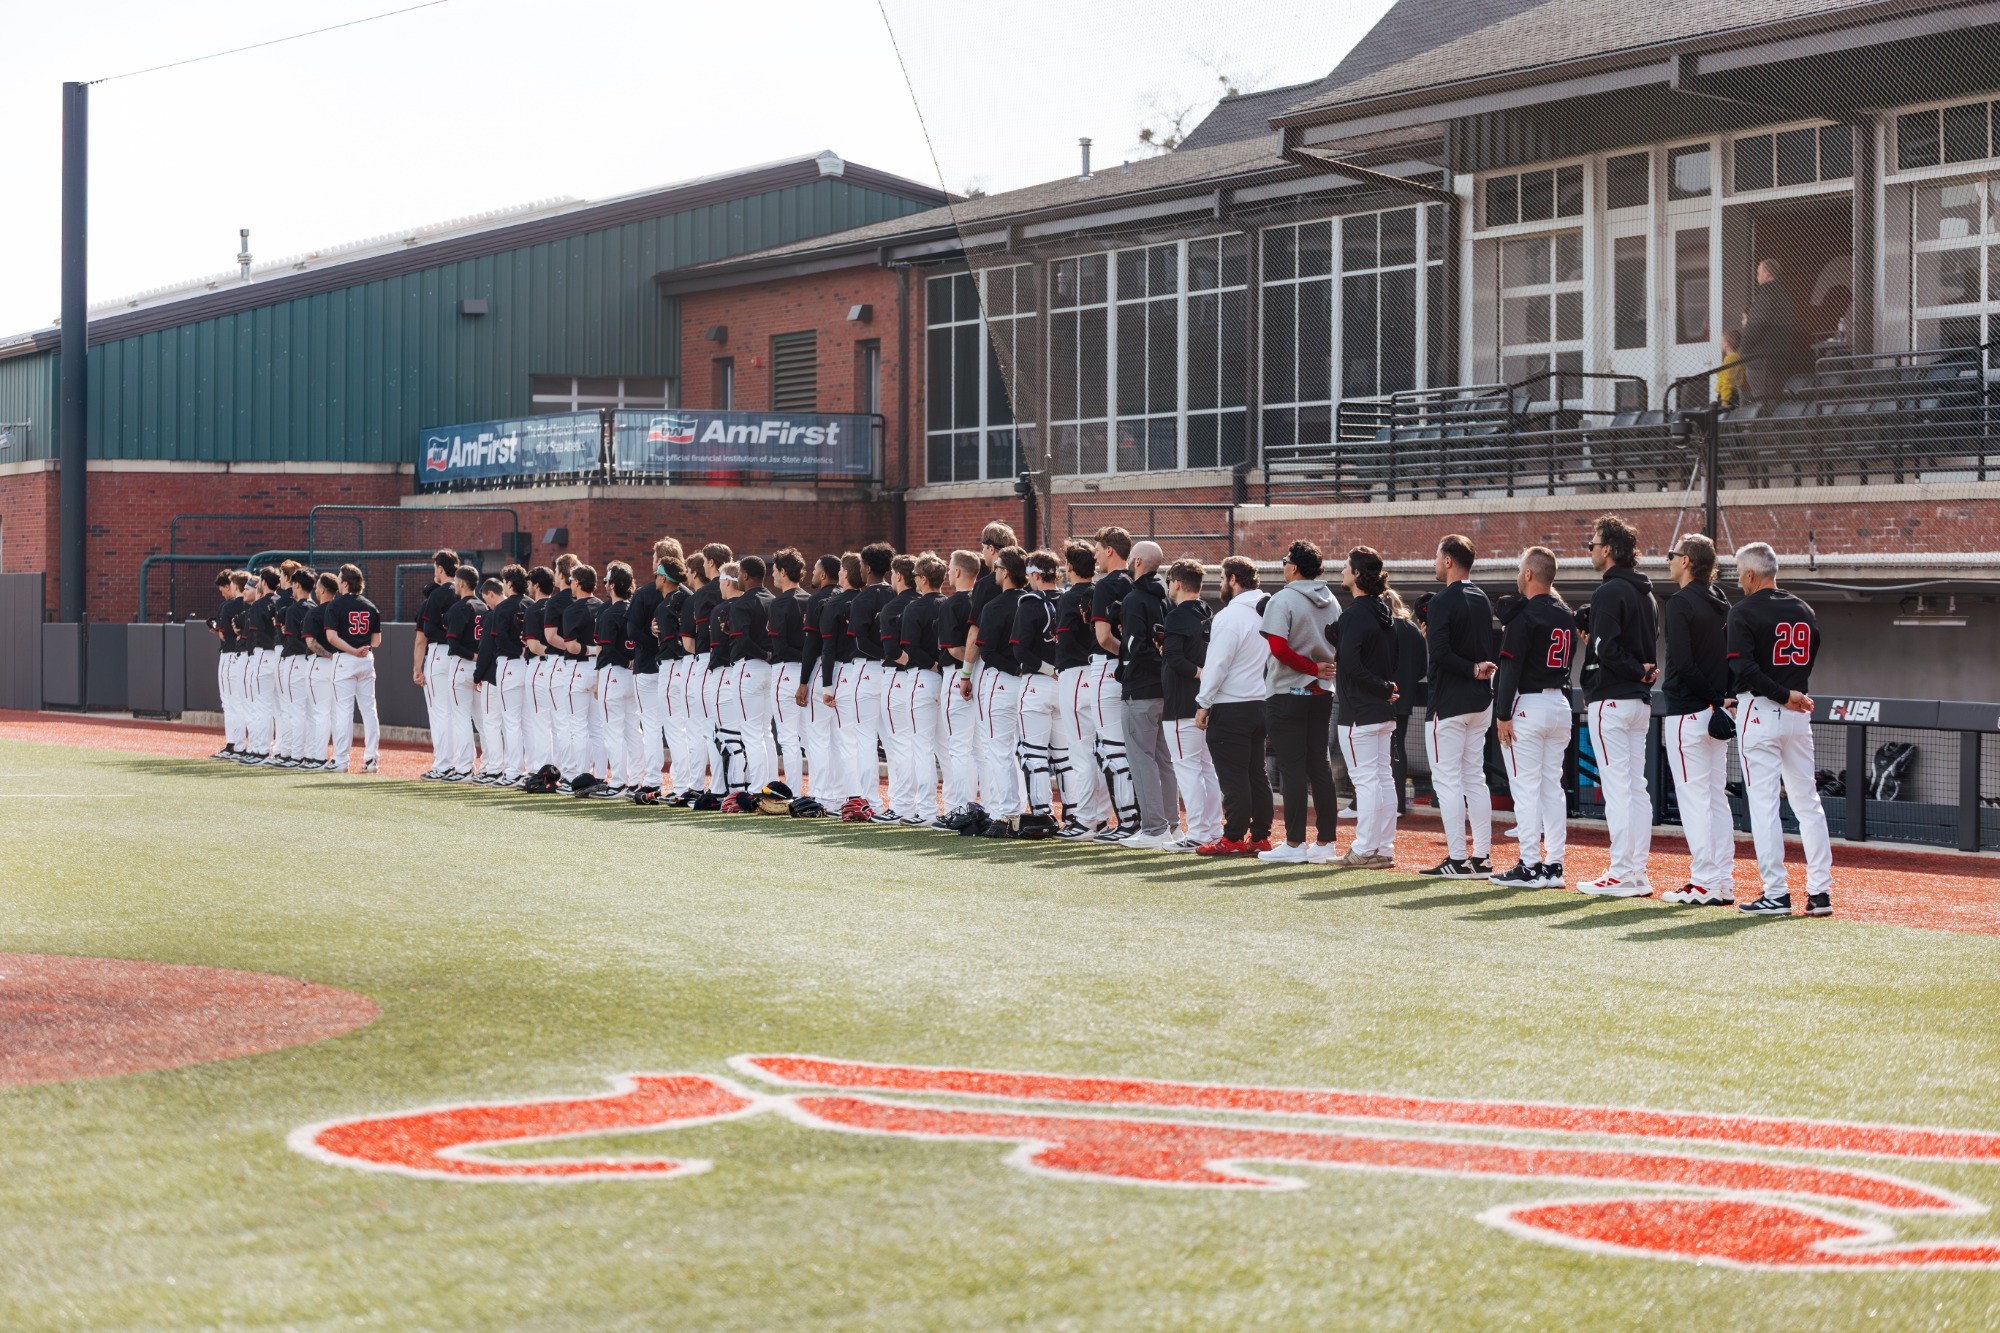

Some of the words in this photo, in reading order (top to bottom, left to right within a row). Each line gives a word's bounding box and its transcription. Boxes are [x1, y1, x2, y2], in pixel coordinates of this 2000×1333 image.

[700, 420, 840, 445] AmFirst
[448, 430, 518, 468] AmFirst
[691, 454, 721, 462] financial
[723, 455, 758, 463] institution
[782, 456, 800, 464] State
[348, 611, 370, 635] 55
[1547, 628, 1570, 668] 21
[1773, 622, 1811, 665] 29
